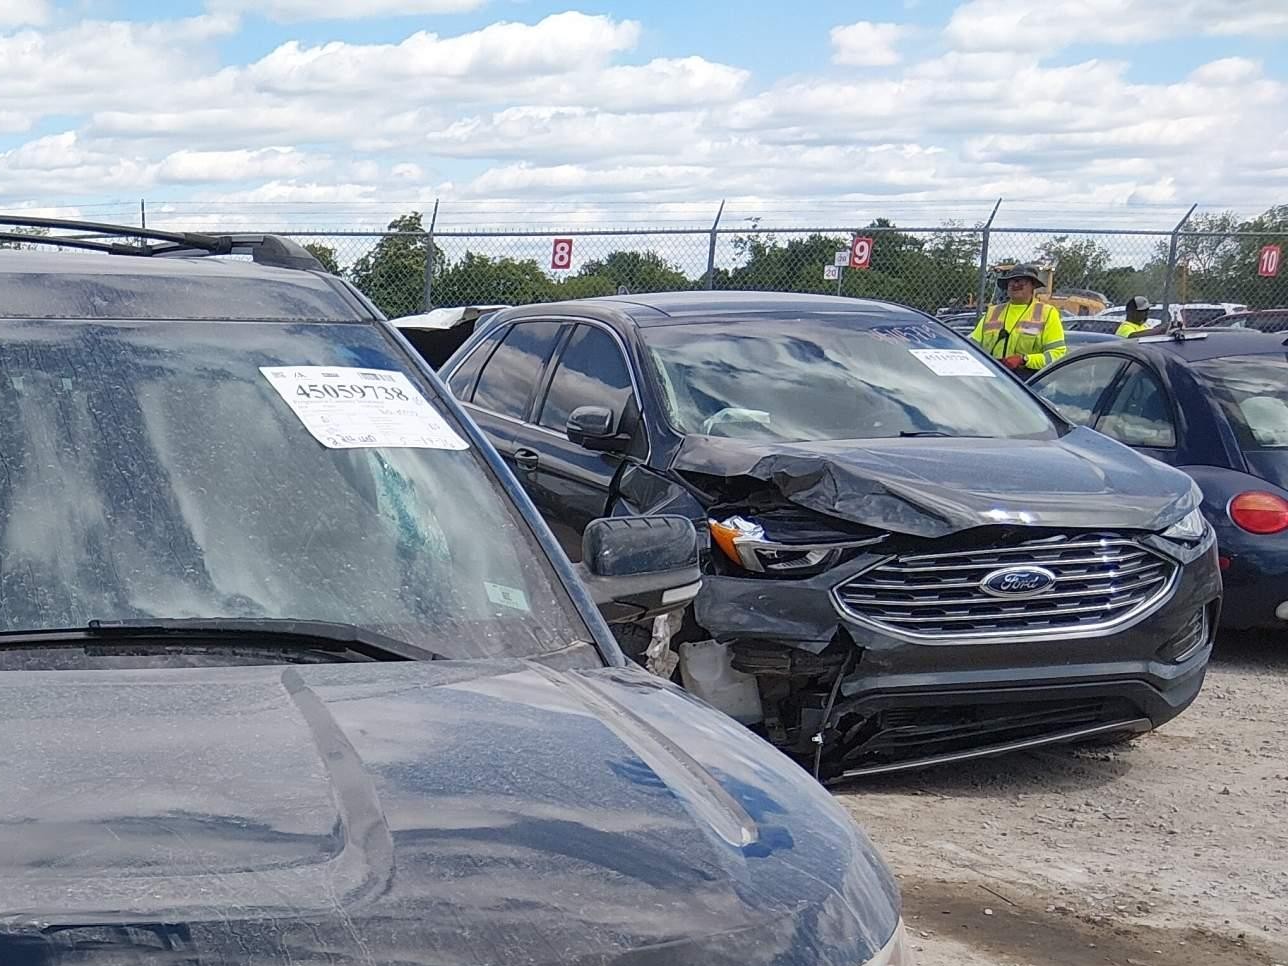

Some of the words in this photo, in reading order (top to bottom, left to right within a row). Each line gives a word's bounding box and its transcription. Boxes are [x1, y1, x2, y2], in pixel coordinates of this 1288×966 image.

[554, 242, 570, 266] 8
[854, 240, 869, 265] 9
[1262, 249, 1277, 273] 10
[295, 384, 409, 402] 45059738
[1000, 573, 1040, 590] Ford
